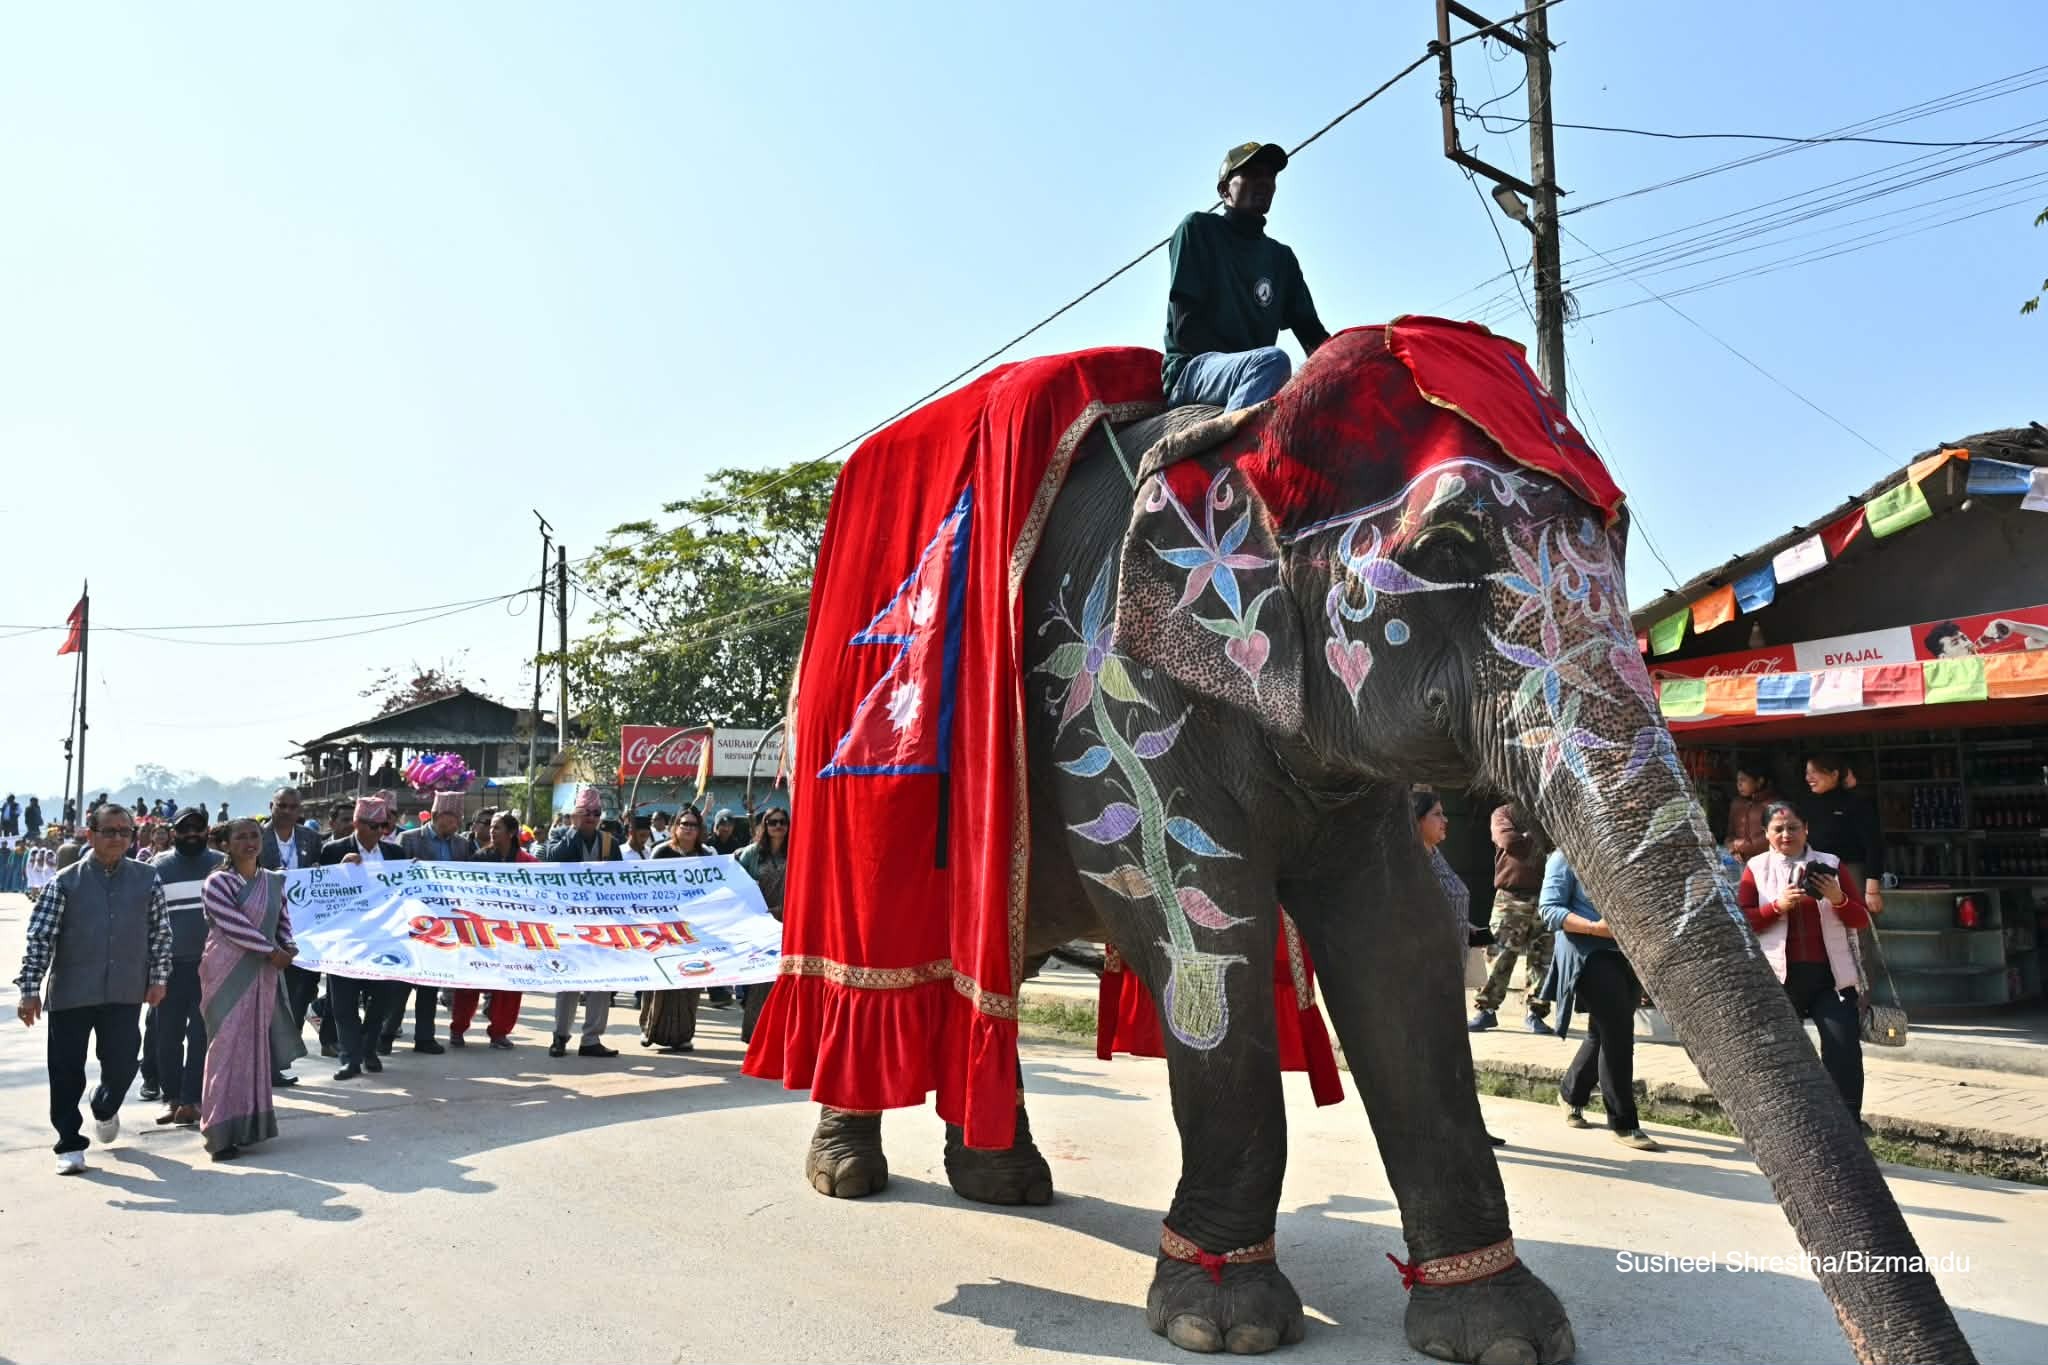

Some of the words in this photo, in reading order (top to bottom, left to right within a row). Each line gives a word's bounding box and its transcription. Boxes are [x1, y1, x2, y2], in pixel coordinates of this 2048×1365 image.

[1824, 648, 1883, 666] BYAJAL
[432, 867, 490, 883] चितवन
[534, 872, 566, 886] तथा
[568, 868, 616, 887] पर्यटन
[311, 885, 363, 898] ELEPHANT
